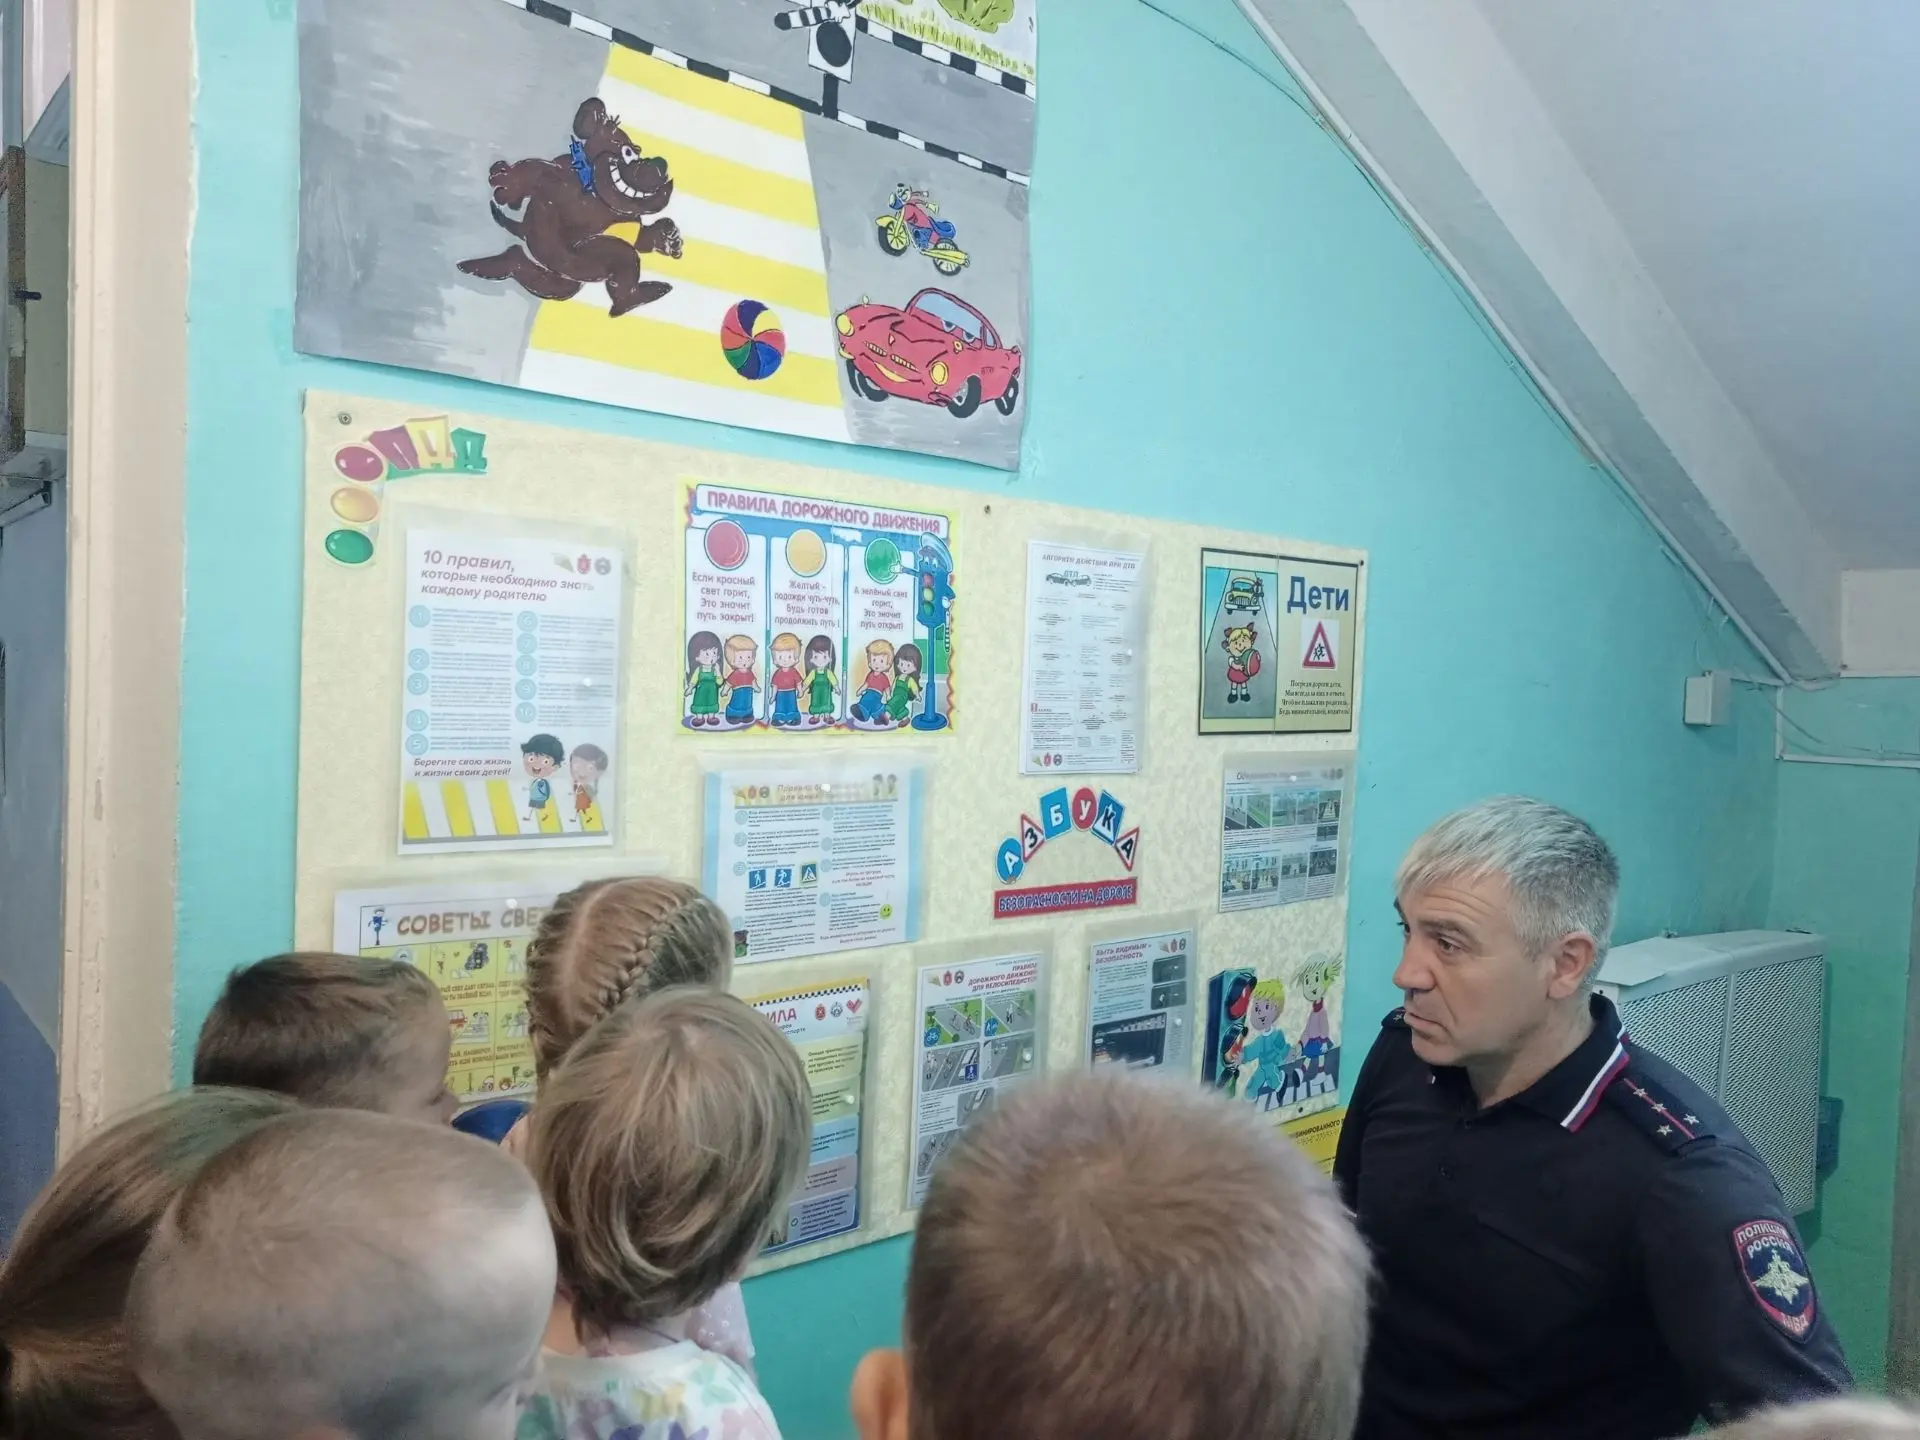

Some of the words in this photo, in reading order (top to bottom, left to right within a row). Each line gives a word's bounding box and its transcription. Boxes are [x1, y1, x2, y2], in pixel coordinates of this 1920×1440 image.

[707, 491, 777, 515] ПРАВИЛА
[781, 499, 869, 526] ДОРОЖНОГО
[872, 511, 941, 535] ДВИЖЕНИЯ
[423, 550, 442, 565] 10
[446, 554, 515, 573] правил,
[421, 569, 478, 583] которые
[480, 575, 557, 589] необходимо
[560, 580, 594, 591] знать
[692, 571, 714, 582] Если
[716, 576, 755, 586] красный
[421, 585, 481, 599] каждому
[484, 589, 547, 602] родителю
[700, 587, 720, 595] свет
[723, 589, 750, 599] горит,
[774, 592, 806, 602] подожди
[1287, 576, 1349, 614] Дети
[701, 598, 717, 607] Это
[720, 601, 750, 610] значит
[786, 603, 805, 614] Будь
[697, 612, 716, 622] путь
[720, 613, 754, 624] закрыт!
[774, 616, 818, 626] продолжить
[864, 609, 876, 617] Это
[878, 611, 901, 619] значит
[860, 621, 876, 630] путь
[414, 758, 457, 767] Берегите
[458, 758, 483, 766] свою
[484, 758, 512, 766] жизнь
[422, 769, 453, 777] жизни
[454, 768, 480, 777] своих
[482, 767, 511, 777] детей!
[1003, 798, 1135, 875] АЗБУКА
[998, 890, 1079, 912] БЕЗОПАСНОСТИ
[1080, 888, 1093, 905] НА
[1094, 883, 1133, 905] ДОРОГЕ
[397, 910, 491, 936] СОВЕТЫ
[500, 907, 544, 929] СВЕ
[968, 973, 1005, 987] ДОРОЖНОГО
[766, 1008, 797, 1024] ИЛА
[1737, 1223, 1790, 1243] ПОЛИЦИЯ
[1747, 1235, 1794, 1259] РОССИЯ
